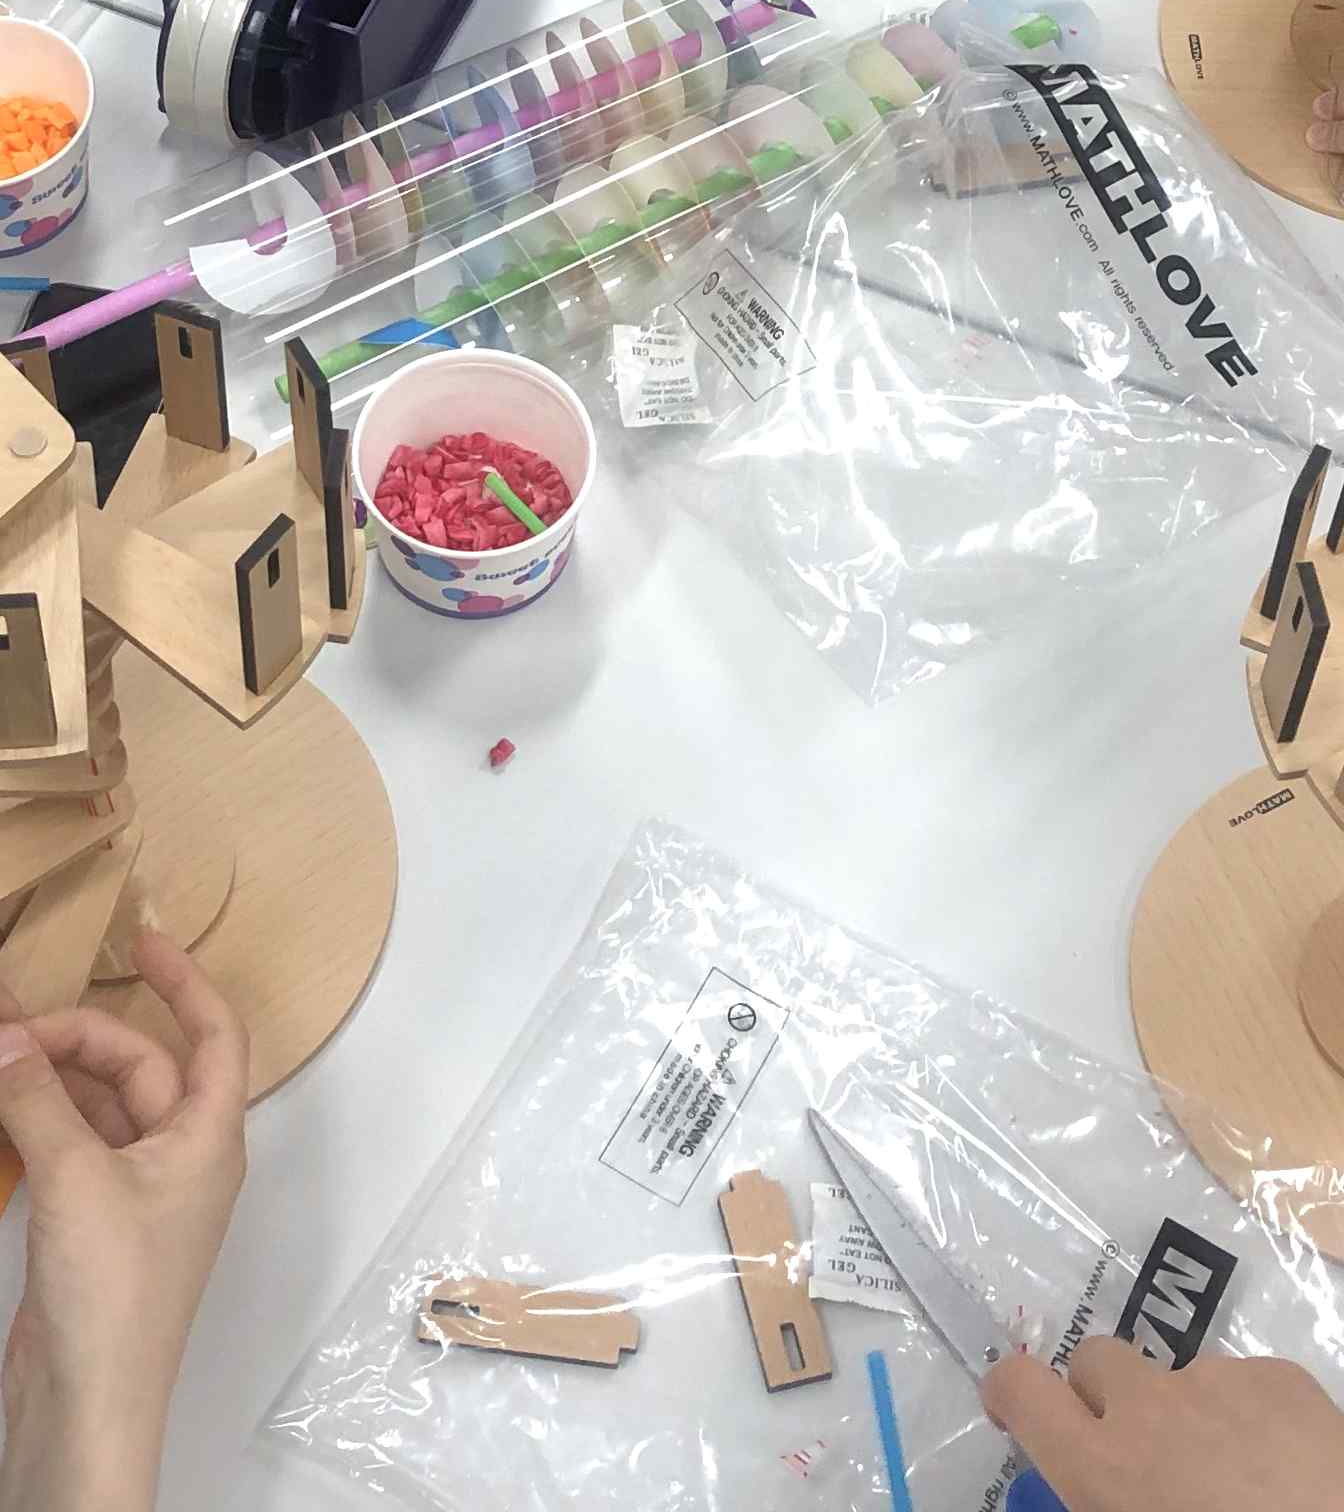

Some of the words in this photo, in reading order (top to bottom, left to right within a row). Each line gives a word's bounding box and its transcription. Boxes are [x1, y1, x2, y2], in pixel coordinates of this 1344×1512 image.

[1188, 33, 1205, 80] MATHLOVE
[1040, 65, 1258, 389] MATHLOVE
[744, 297, 785, 341] WARNING
[1096, 257, 1116, 278] All
[1107, 275, 1140, 317] rights
[1132, 312, 1175, 374] reserved
[1227, 788, 1296, 828] MATHLOVE
[661, 1051, 683, 1081] made
[654, 1080, 667, 1093] in
[677, 1089, 727, 1160] WARNING
[825, 1258, 856, 1273] GEL
[862, 1251, 882, 1262] NOT
[853, 1273, 902, 1292] SILICA
